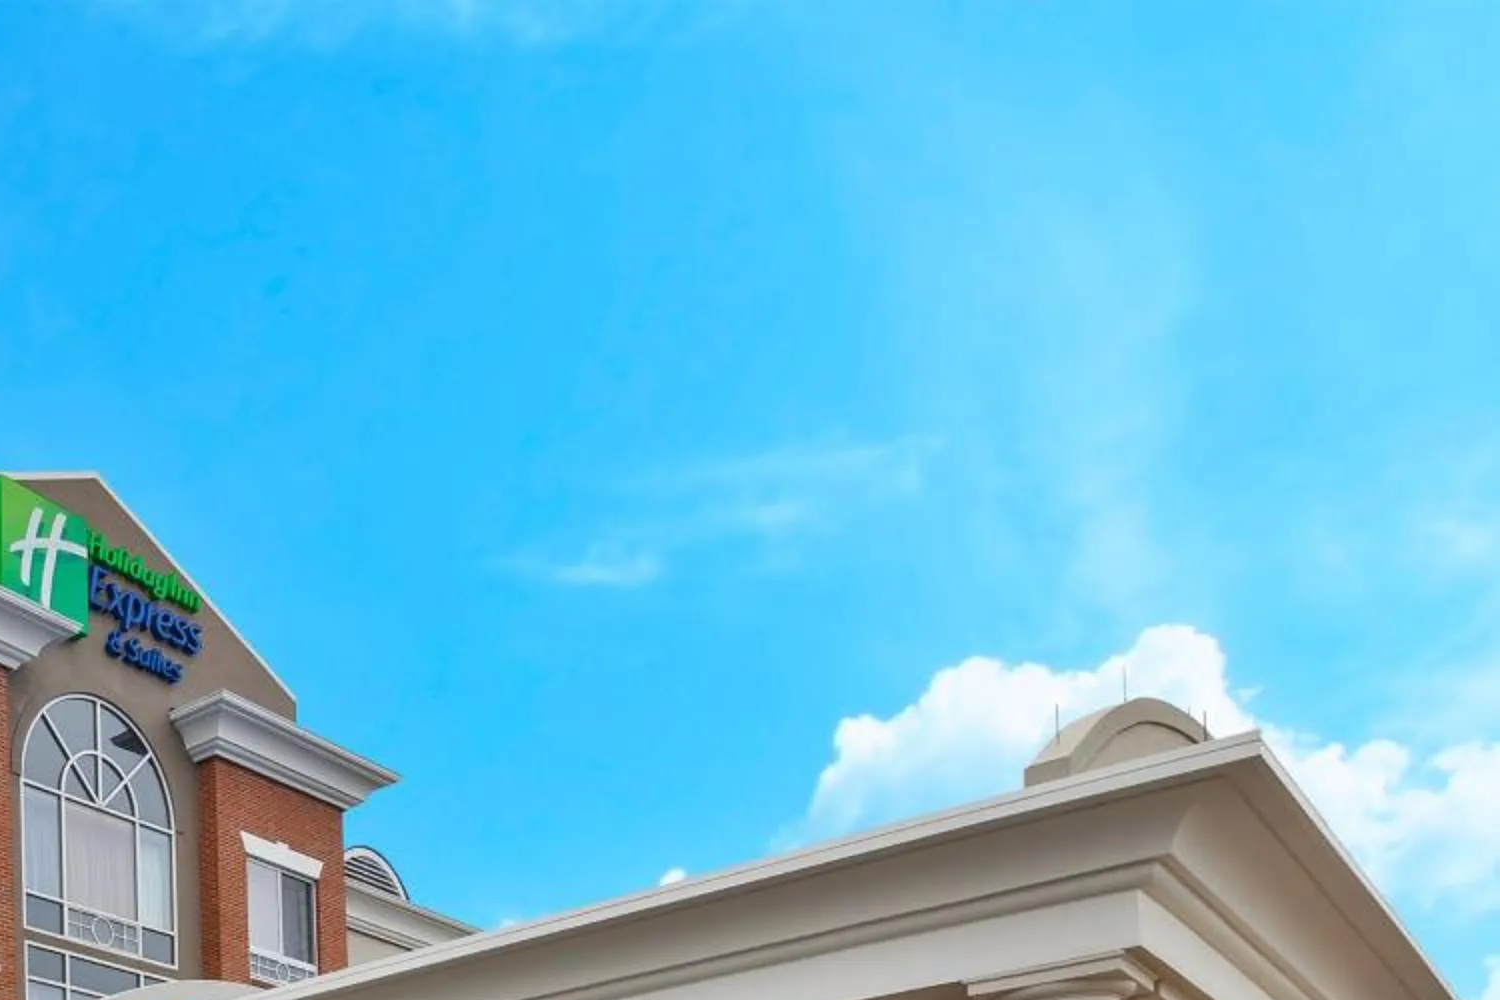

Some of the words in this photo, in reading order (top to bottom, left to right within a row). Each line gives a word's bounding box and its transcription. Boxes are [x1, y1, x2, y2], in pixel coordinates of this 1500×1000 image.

[87, 531, 168, 600] Holiday
[167, 572, 202, 613] Inn
[89, 564, 203, 656] Express
[105, 630, 124, 659] &
[123, 638, 183, 684] Suites
